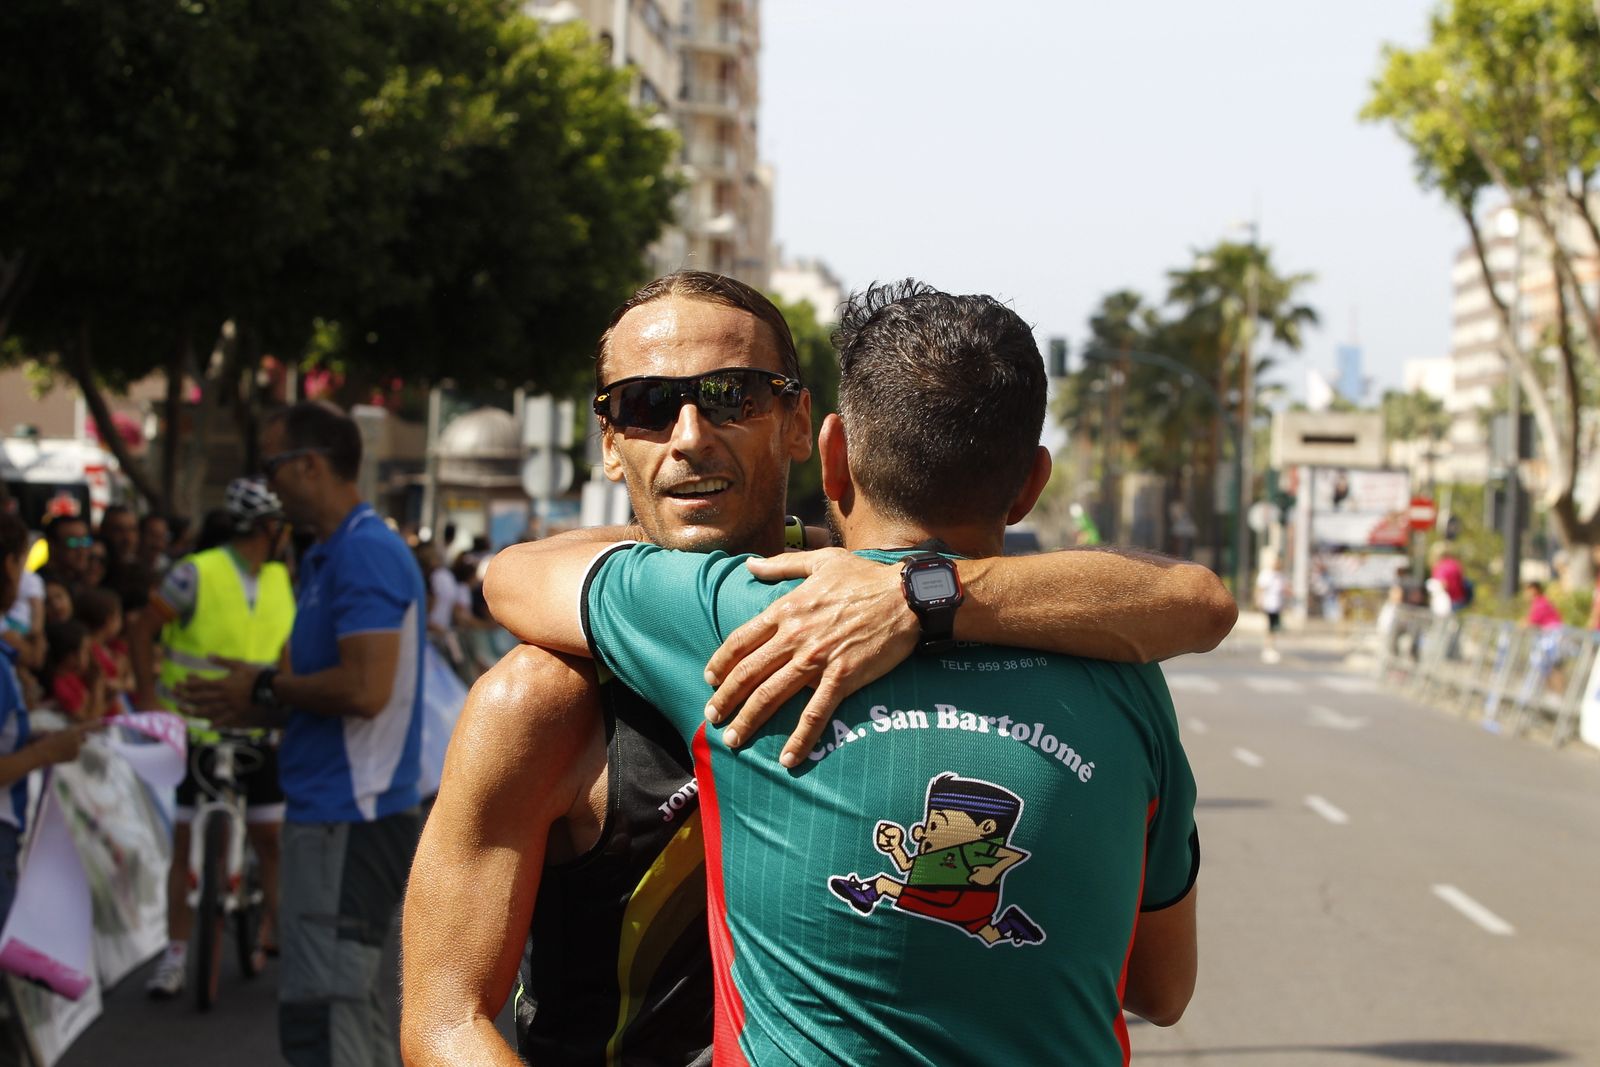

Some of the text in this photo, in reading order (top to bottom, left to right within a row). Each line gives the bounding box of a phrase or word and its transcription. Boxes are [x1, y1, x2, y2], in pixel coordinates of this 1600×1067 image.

[940, 656, 1048, 672] TELF. 959 38 60 10
[869, 704, 930, 733] San
[934, 703, 1096, 783] Bartolomé
